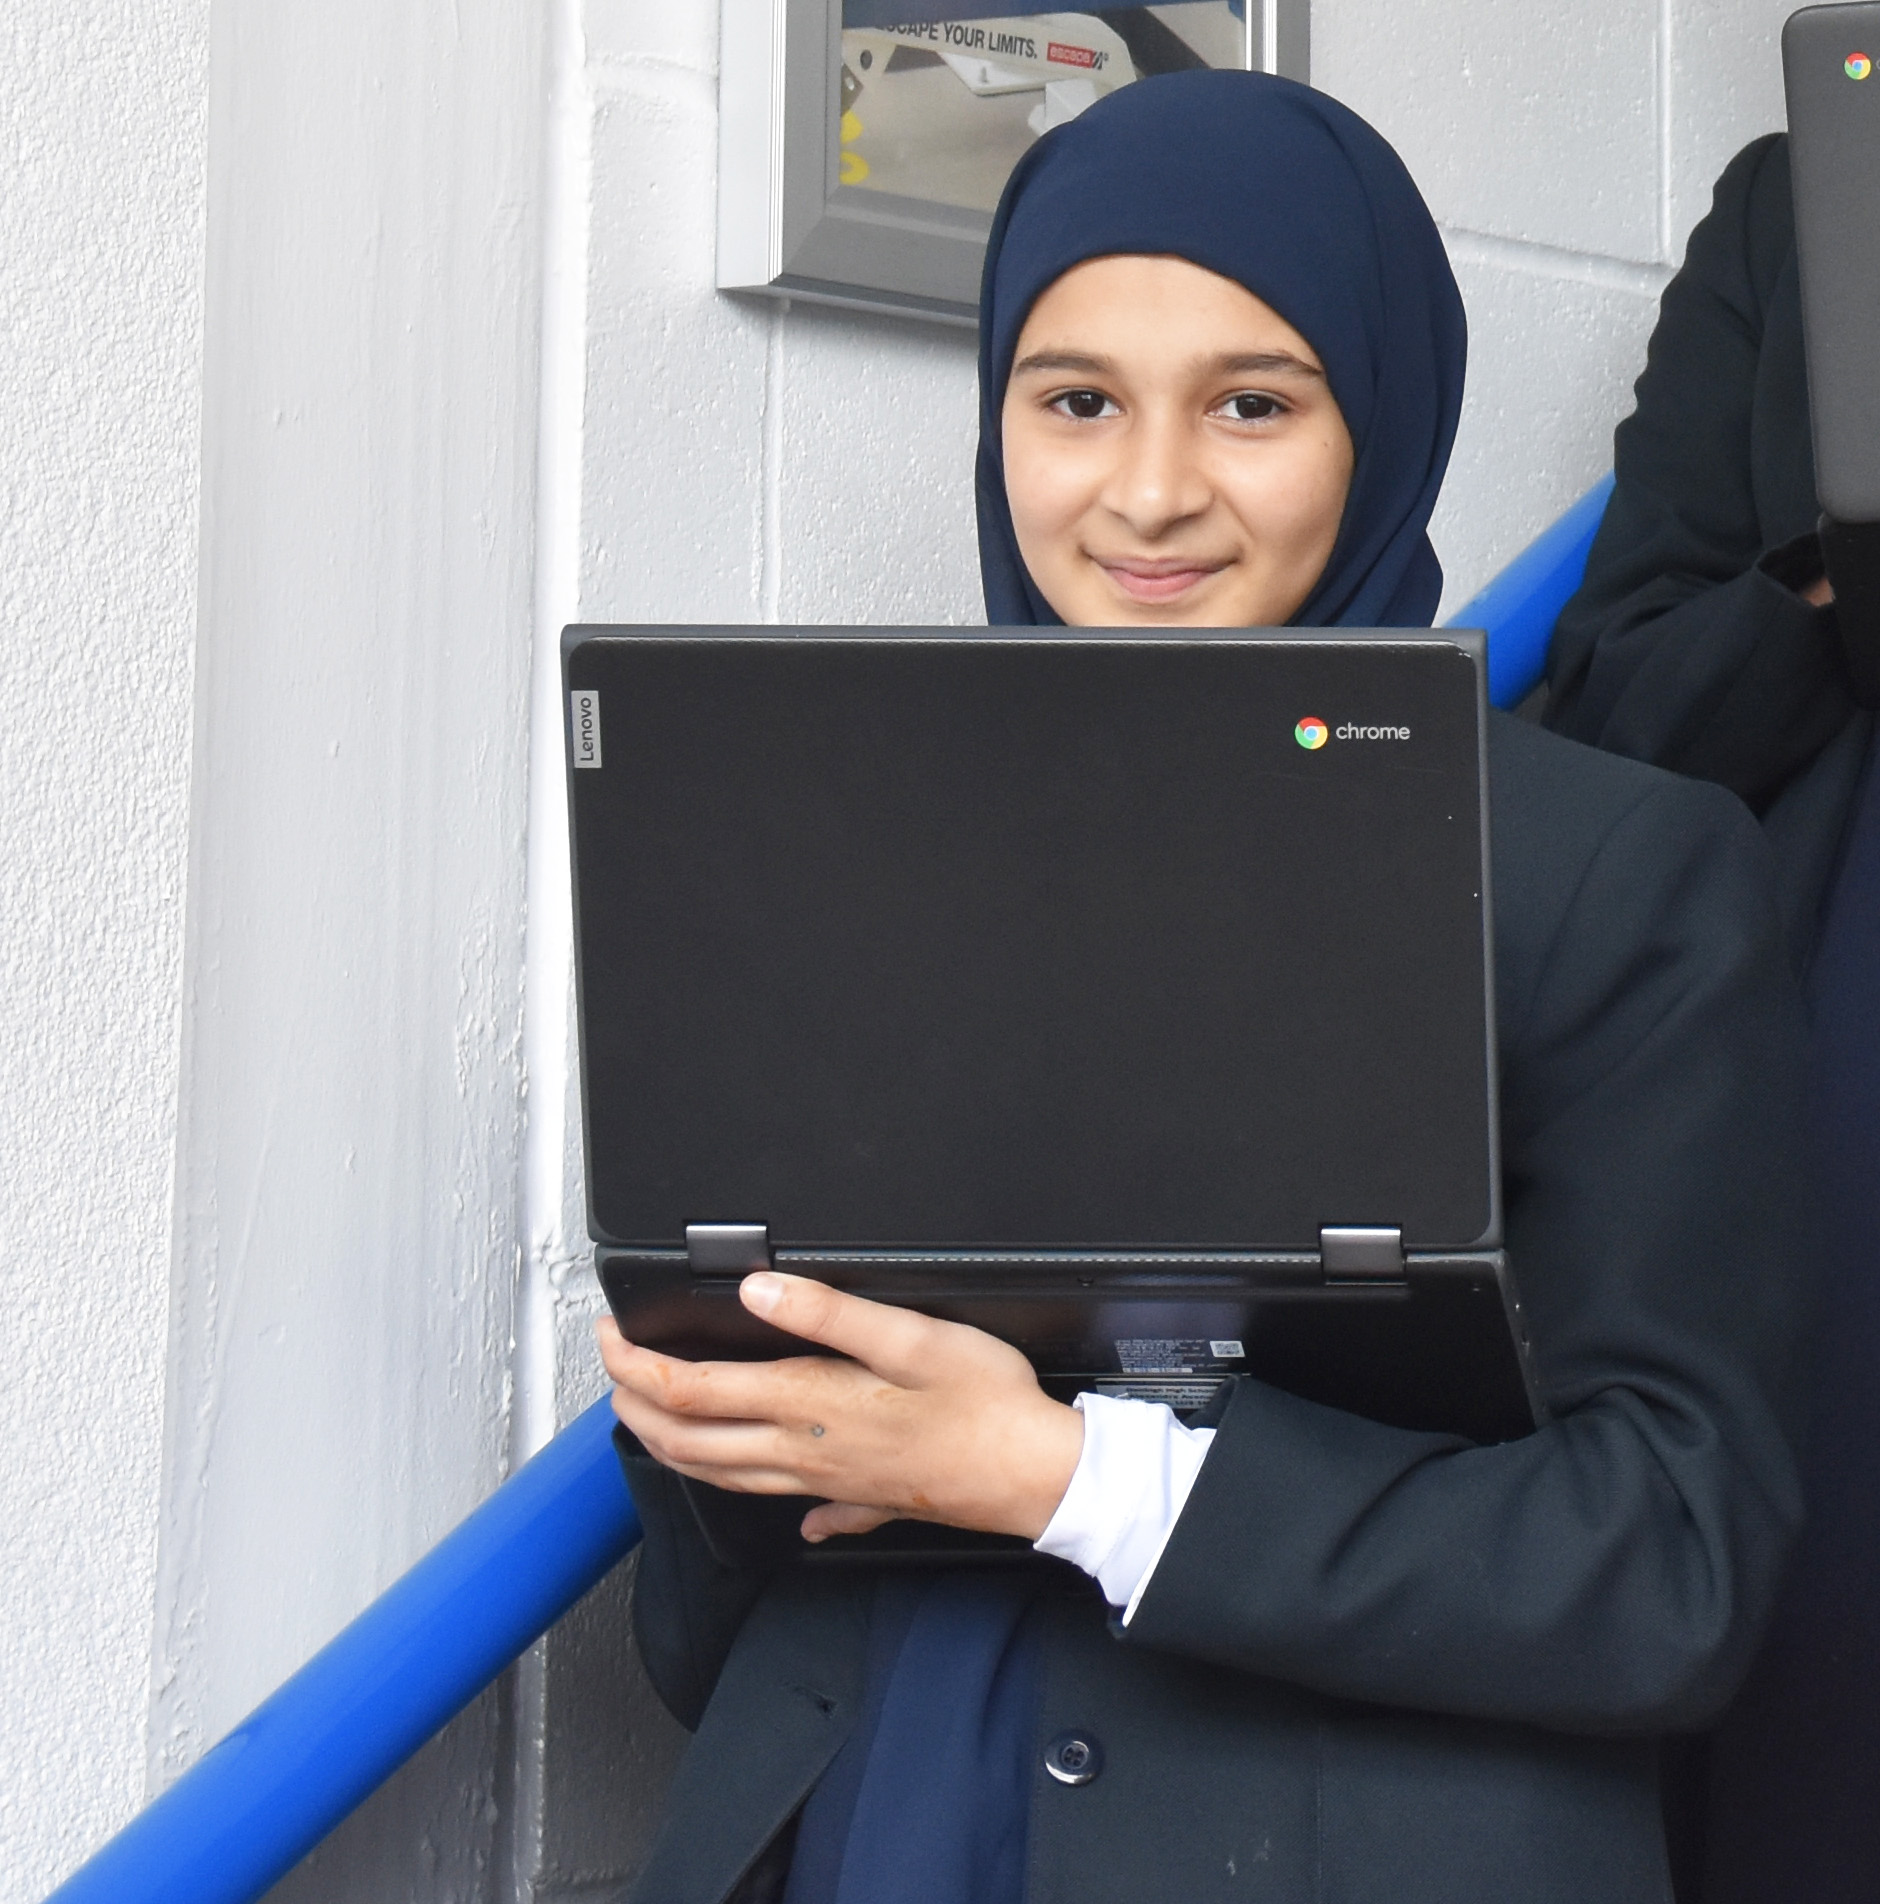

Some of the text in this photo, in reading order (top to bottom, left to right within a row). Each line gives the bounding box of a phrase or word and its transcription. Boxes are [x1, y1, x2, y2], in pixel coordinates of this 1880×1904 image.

[943, 22, 985, 49] YOUR
[988, 31, 1038, 60] LIMITS.
[579, 697, 594, 761] Lenovo
[1335, 721, 1411, 740] chrome
